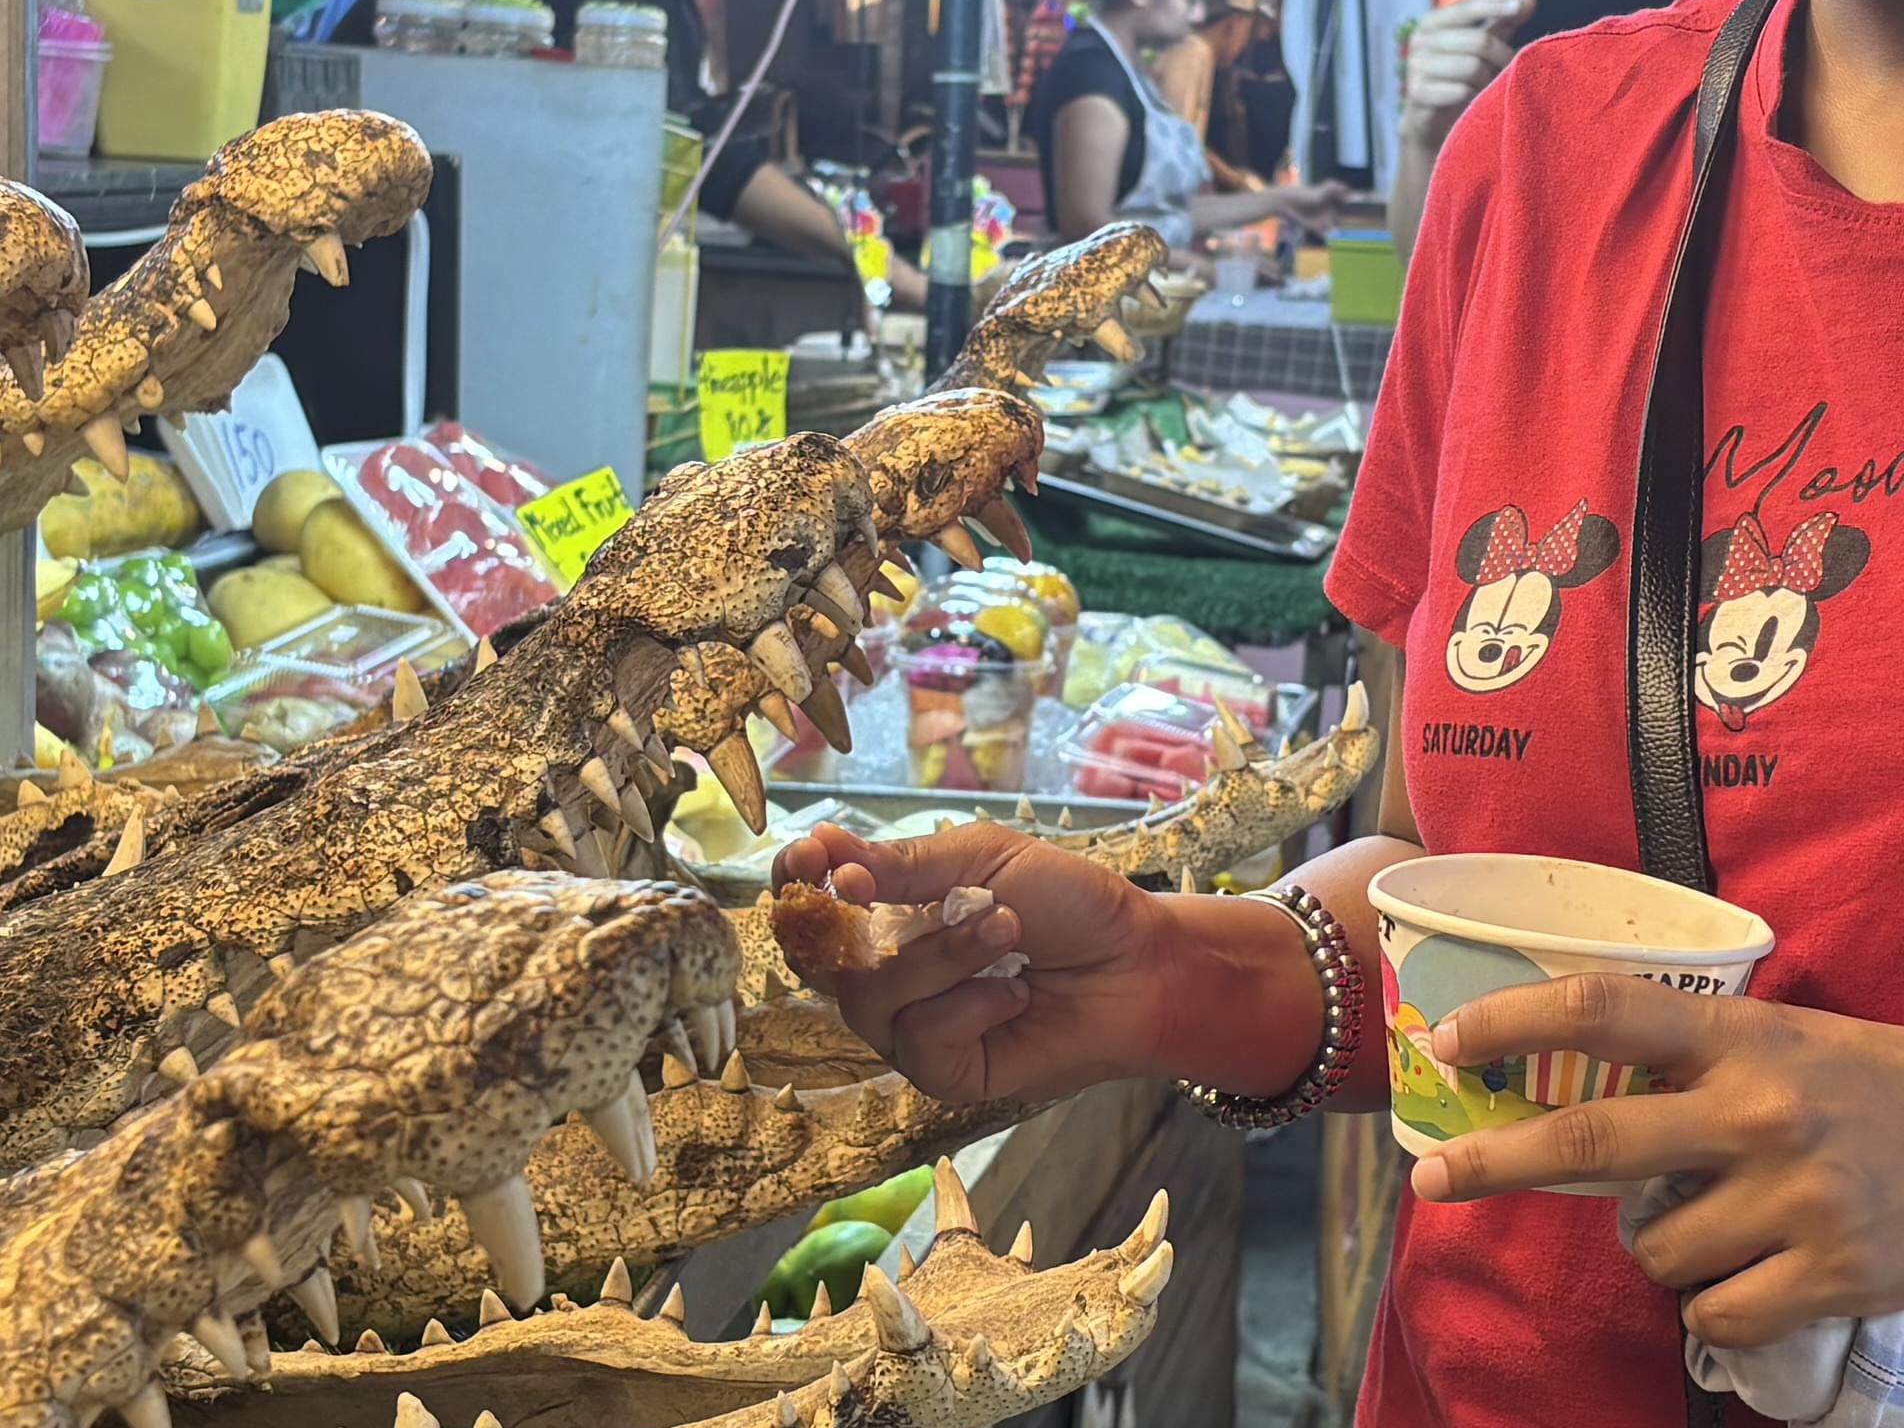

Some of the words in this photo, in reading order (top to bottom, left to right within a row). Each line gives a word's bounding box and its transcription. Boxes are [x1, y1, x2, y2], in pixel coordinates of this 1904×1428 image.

[222, 419, 275, 492] 150
[1421, 723, 1533, 762] SATURDAY
[1702, 753, 1780, 788] NDAY
[1632, 973, 1727, 996] APPY
